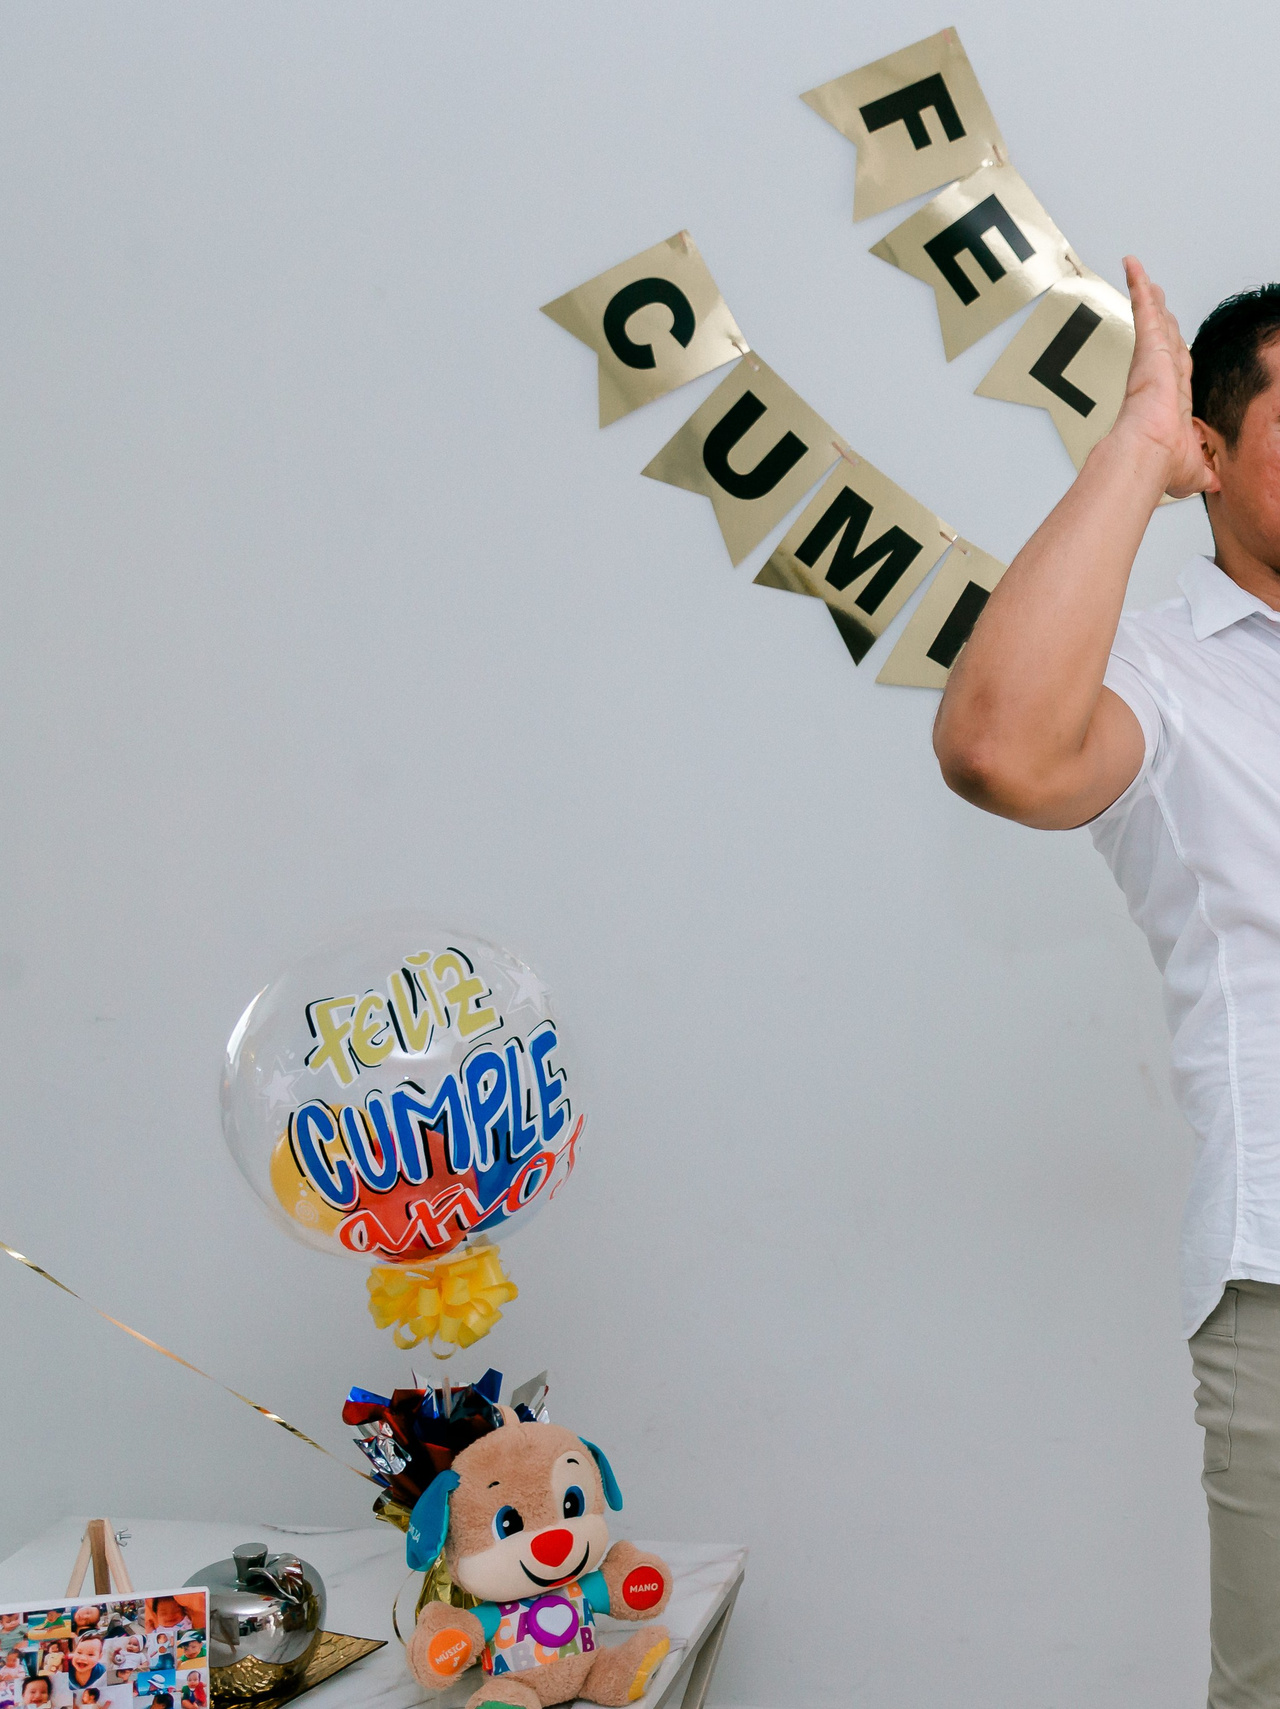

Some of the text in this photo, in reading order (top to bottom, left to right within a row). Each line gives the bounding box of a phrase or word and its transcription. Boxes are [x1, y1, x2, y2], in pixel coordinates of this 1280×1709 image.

[859, 72, 1103, 418] FEL
[603, 277, 990, 669] CUM
[289, 1020, 572, 1212] CUMPLE
[629, 1582, 659, 1594] MANO
